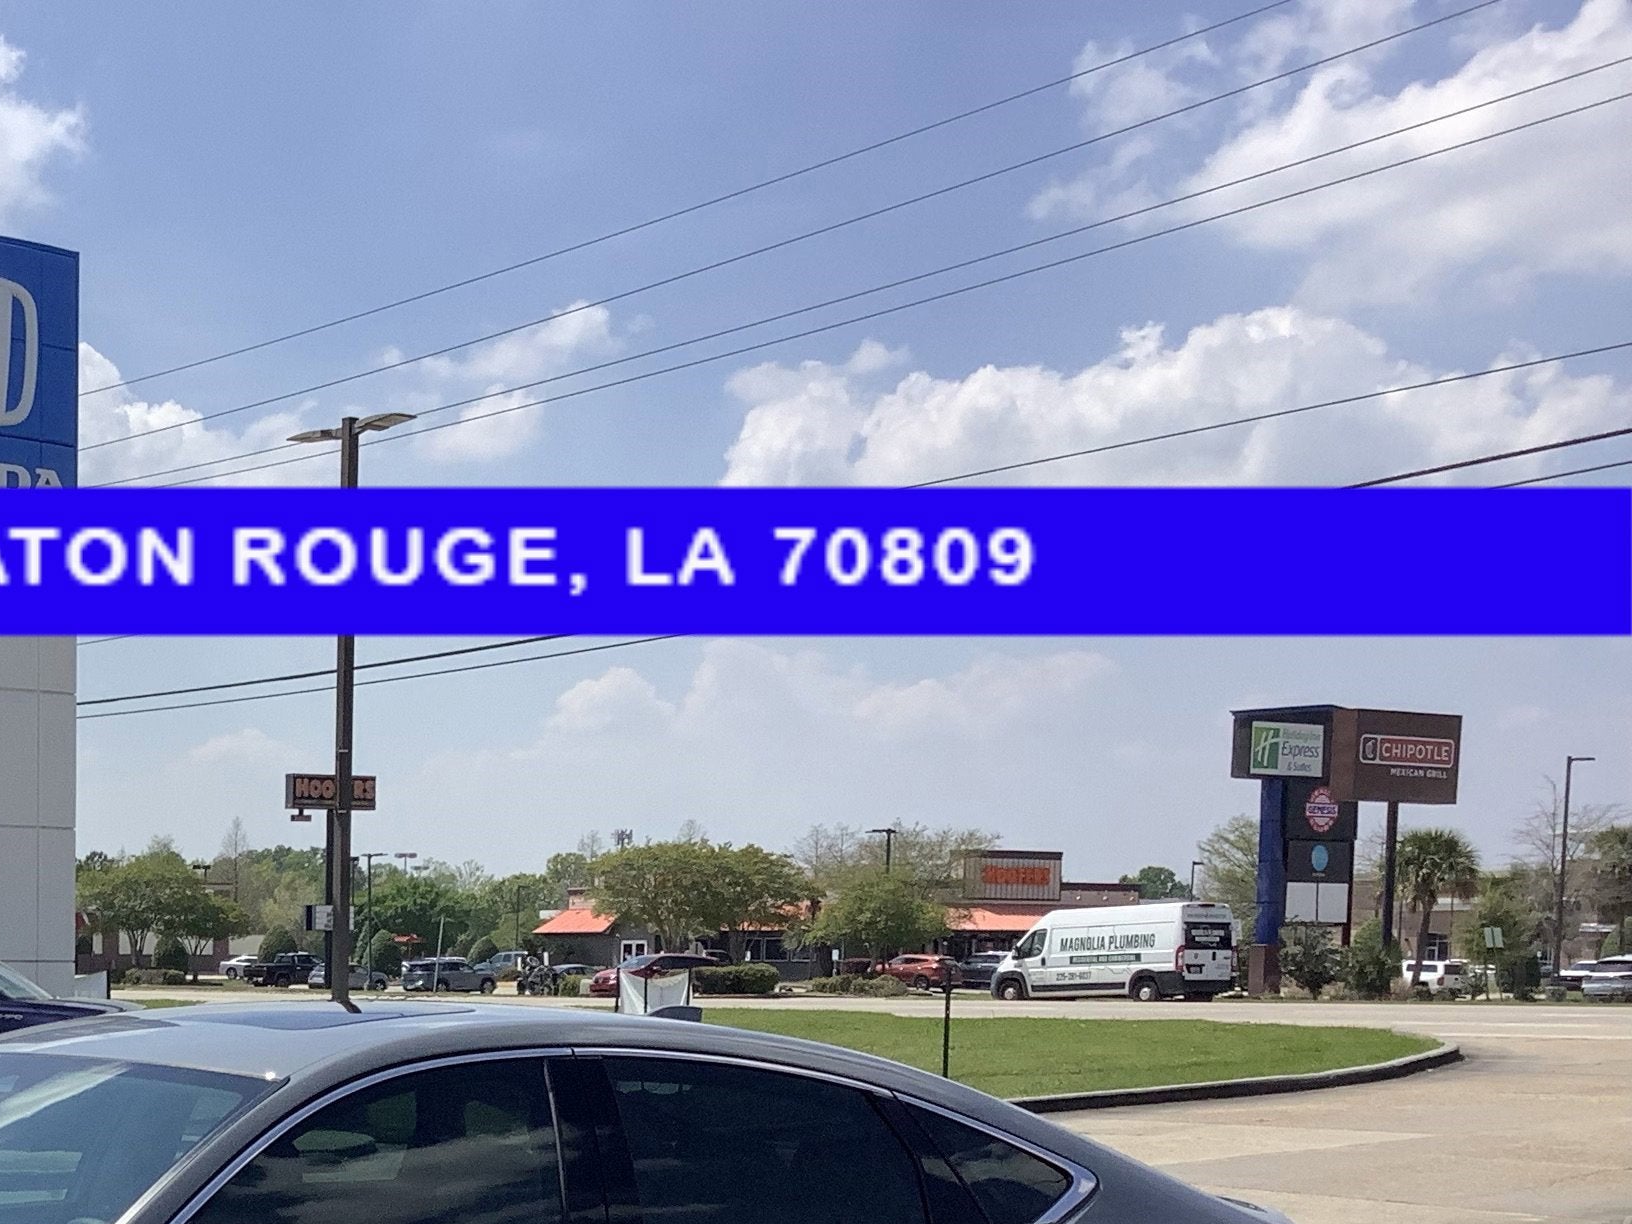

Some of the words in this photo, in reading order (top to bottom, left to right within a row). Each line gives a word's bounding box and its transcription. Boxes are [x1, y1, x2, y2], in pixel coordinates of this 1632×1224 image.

[1281, 740, 1321, 760] Express
[1381, 742, 1450, 761] CHIPOTLE
[1390, 768, 1425, 777] MEXICAN
[1426, 769, 1448, 779] GRILL
[295, 778, 375, 799] HOORS
[1060, 936, 1106, 952] MAGNOLIA
[1109, 933, 1156, 950] PLUMBING
